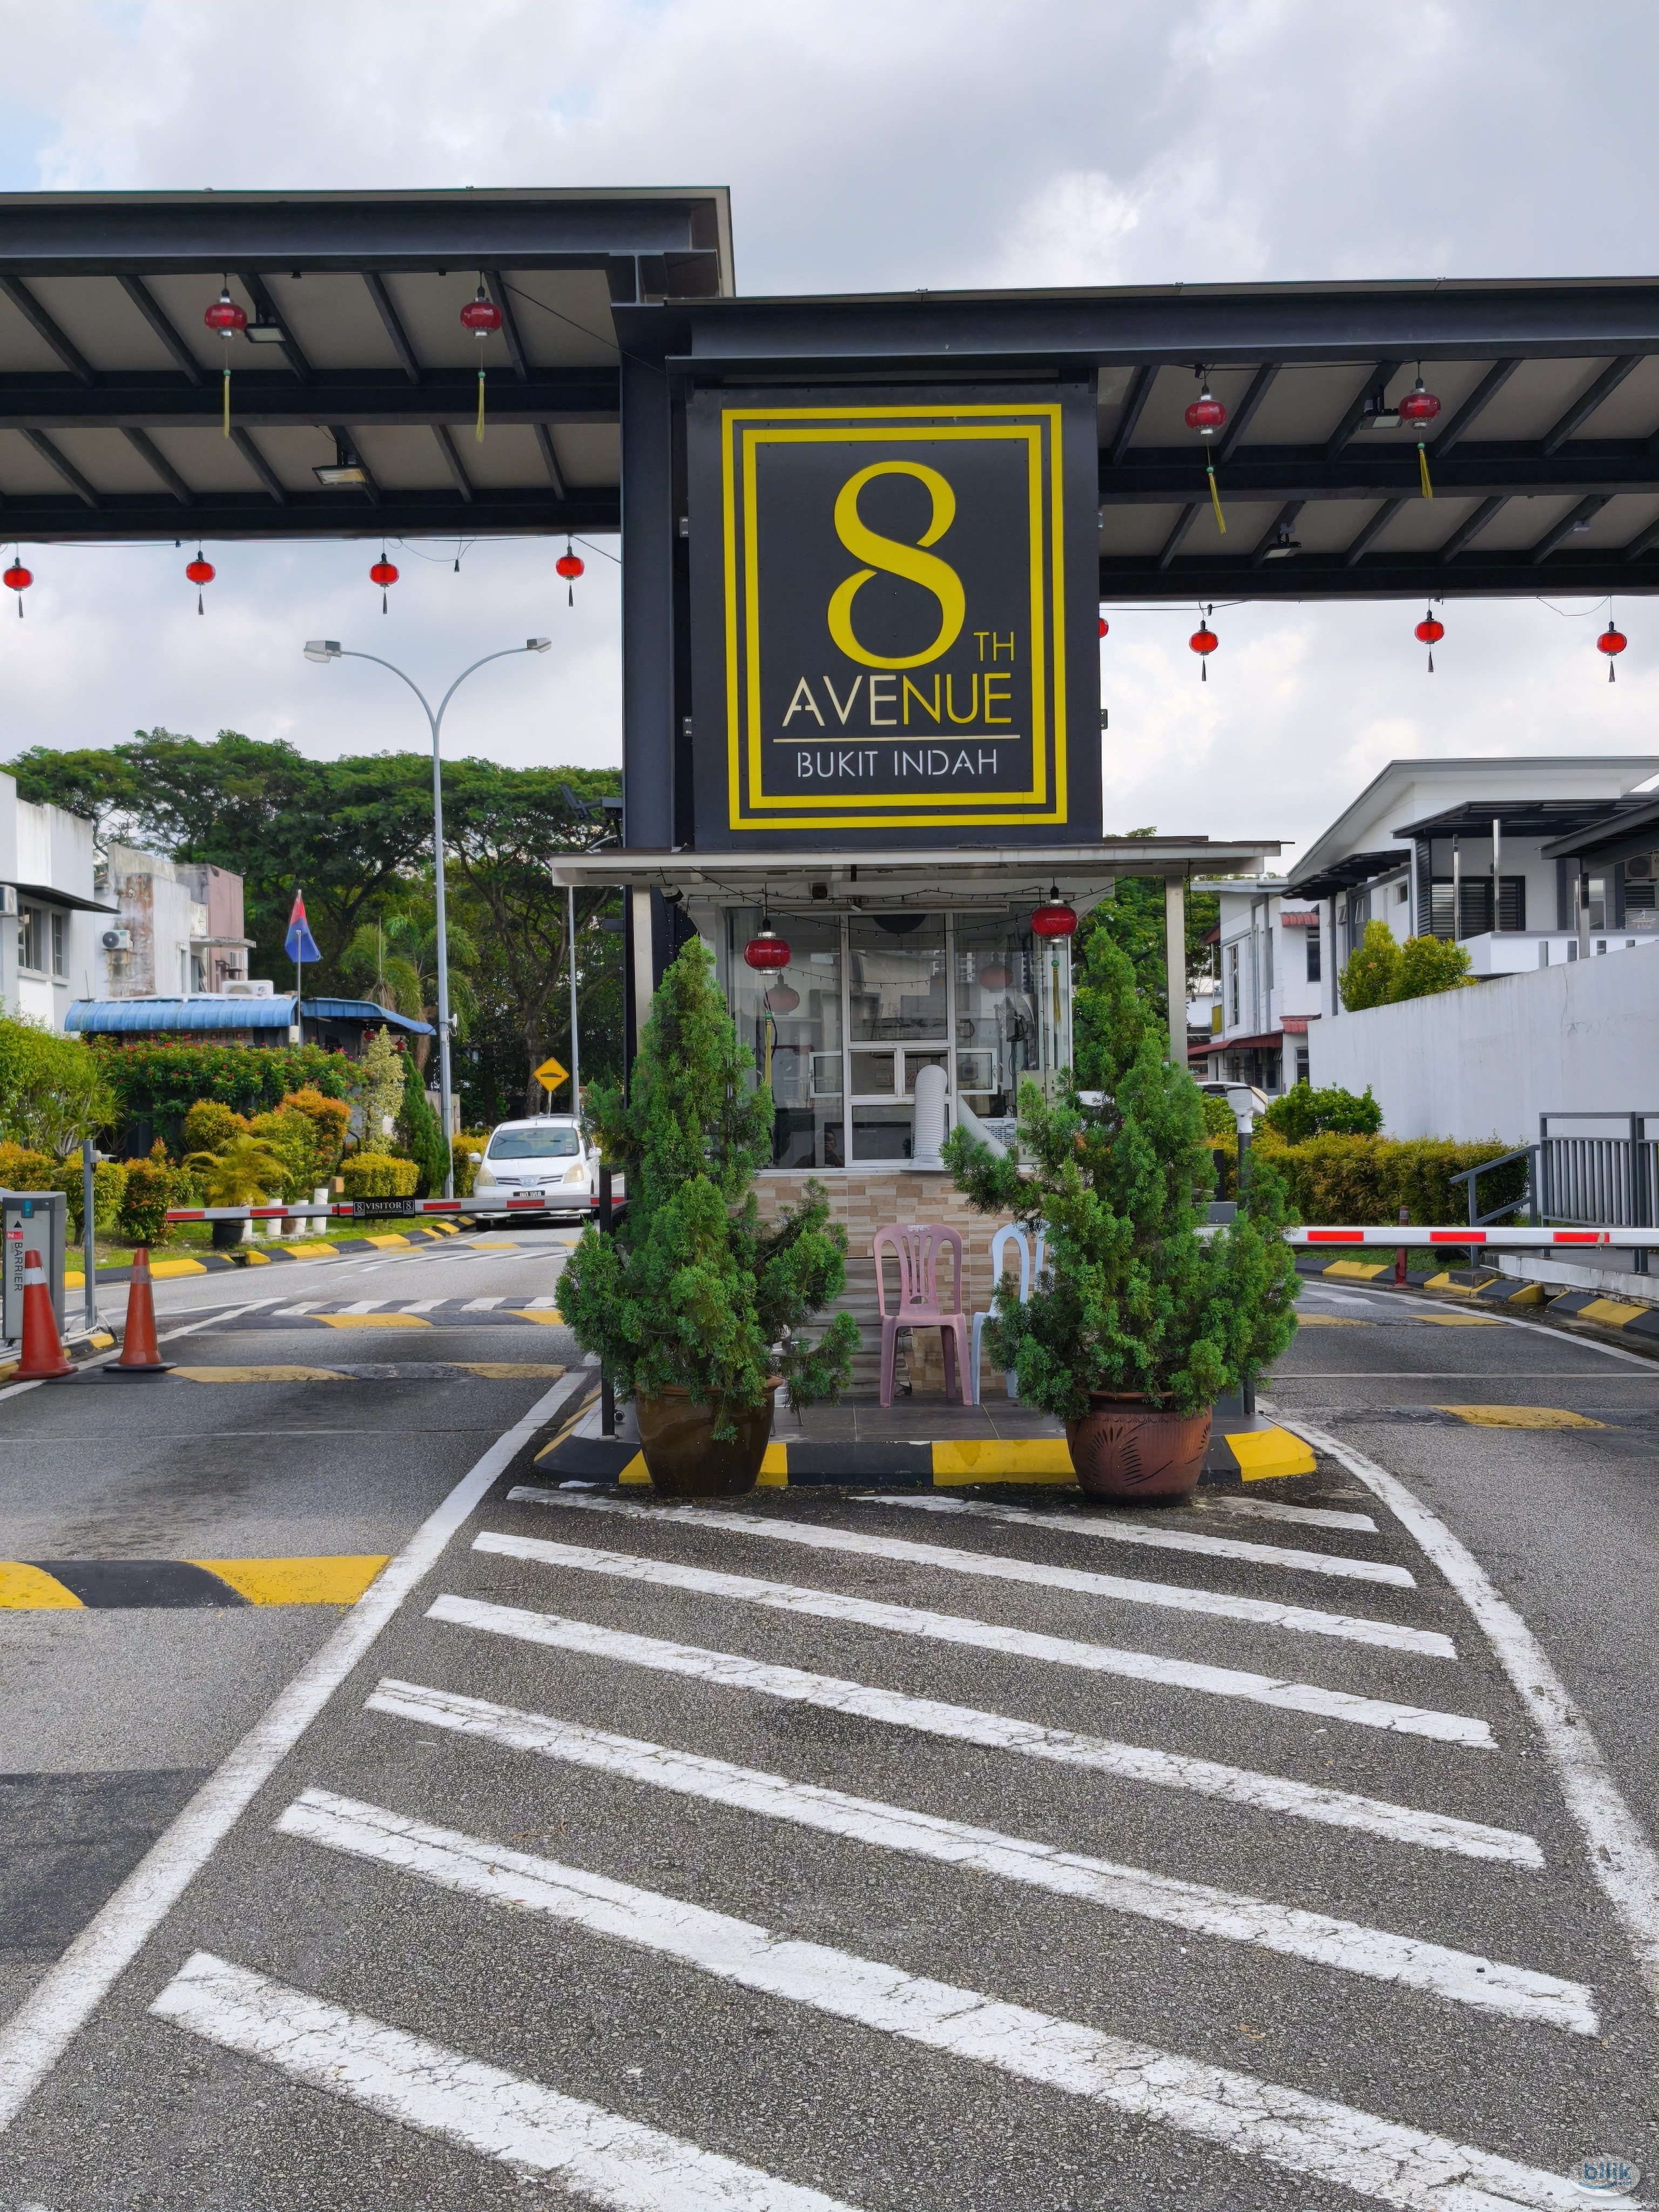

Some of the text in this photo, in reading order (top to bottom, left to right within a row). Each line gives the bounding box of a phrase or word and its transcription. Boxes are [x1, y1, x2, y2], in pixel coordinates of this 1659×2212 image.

[827, 460, 1014, 670] 8 TH
[782, 672, 1011, 727] AVENUE
[797, 749, 997, 778] BUKIT INDAH
[14, 1242, 23, 1291] BARRIER
